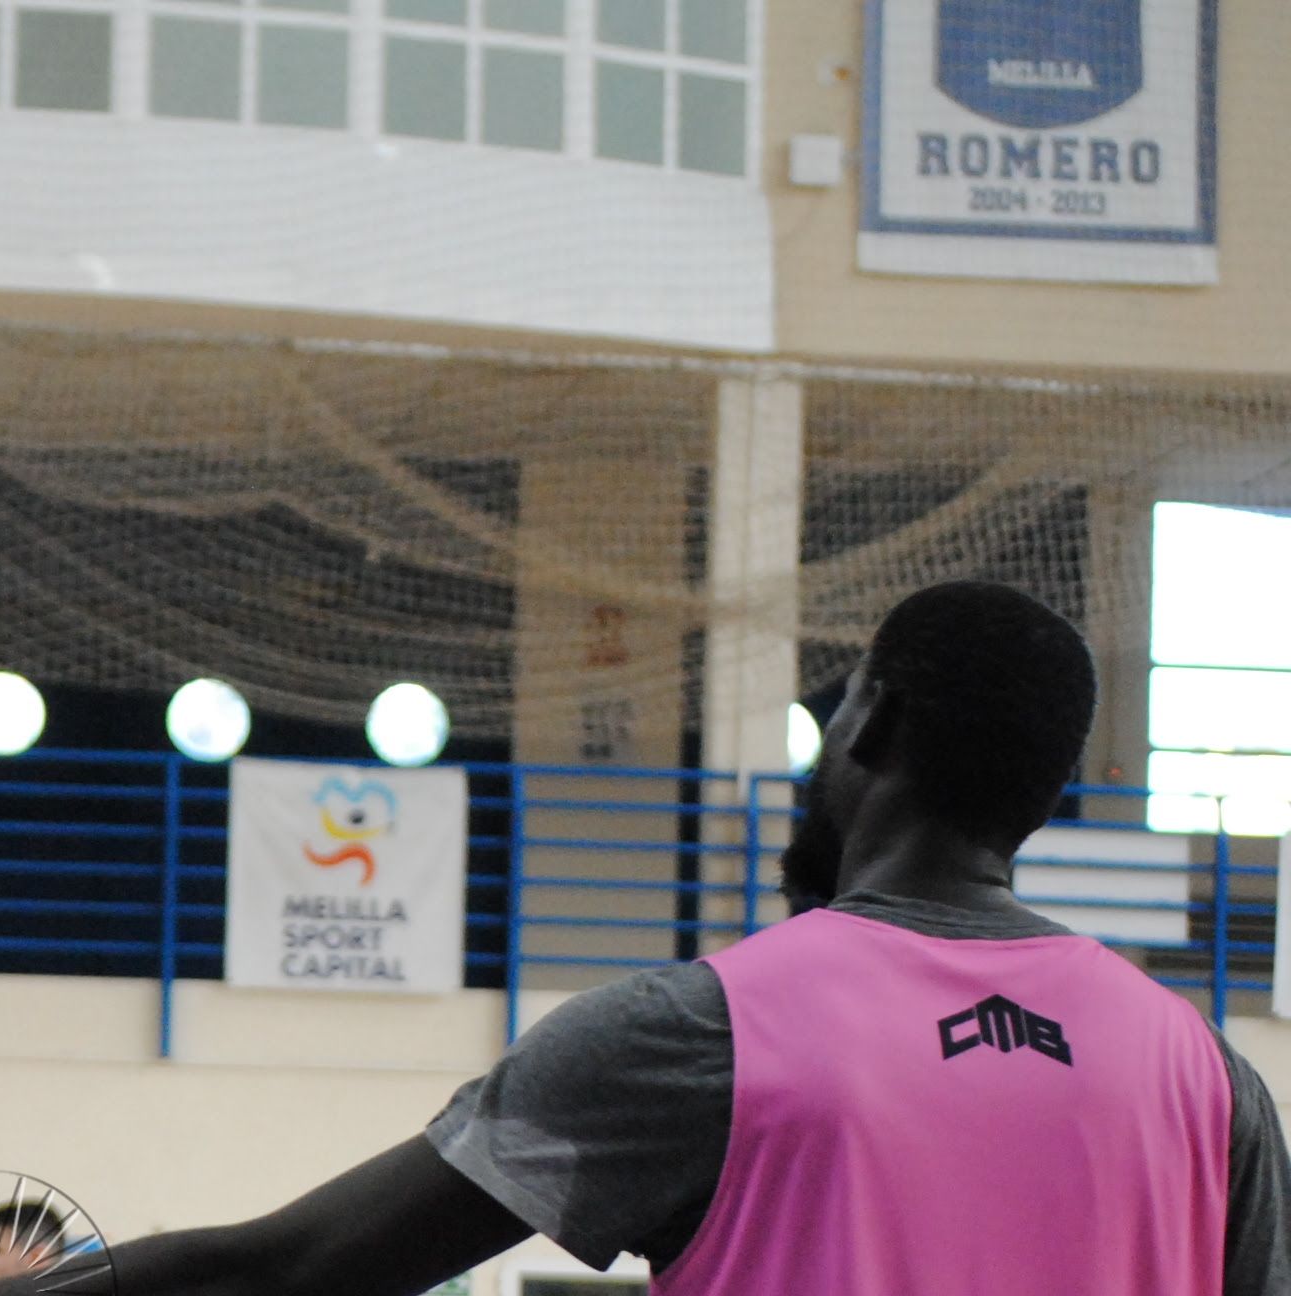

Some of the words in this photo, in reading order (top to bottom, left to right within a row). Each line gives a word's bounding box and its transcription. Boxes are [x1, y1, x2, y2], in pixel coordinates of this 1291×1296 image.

[917, 131, 1161, 184] ROMERO
[282, 897, 406, 922] MELILLA
[283, 924, 384, 950] SPORT
[280, 954, 405, 980] CAPITAL
